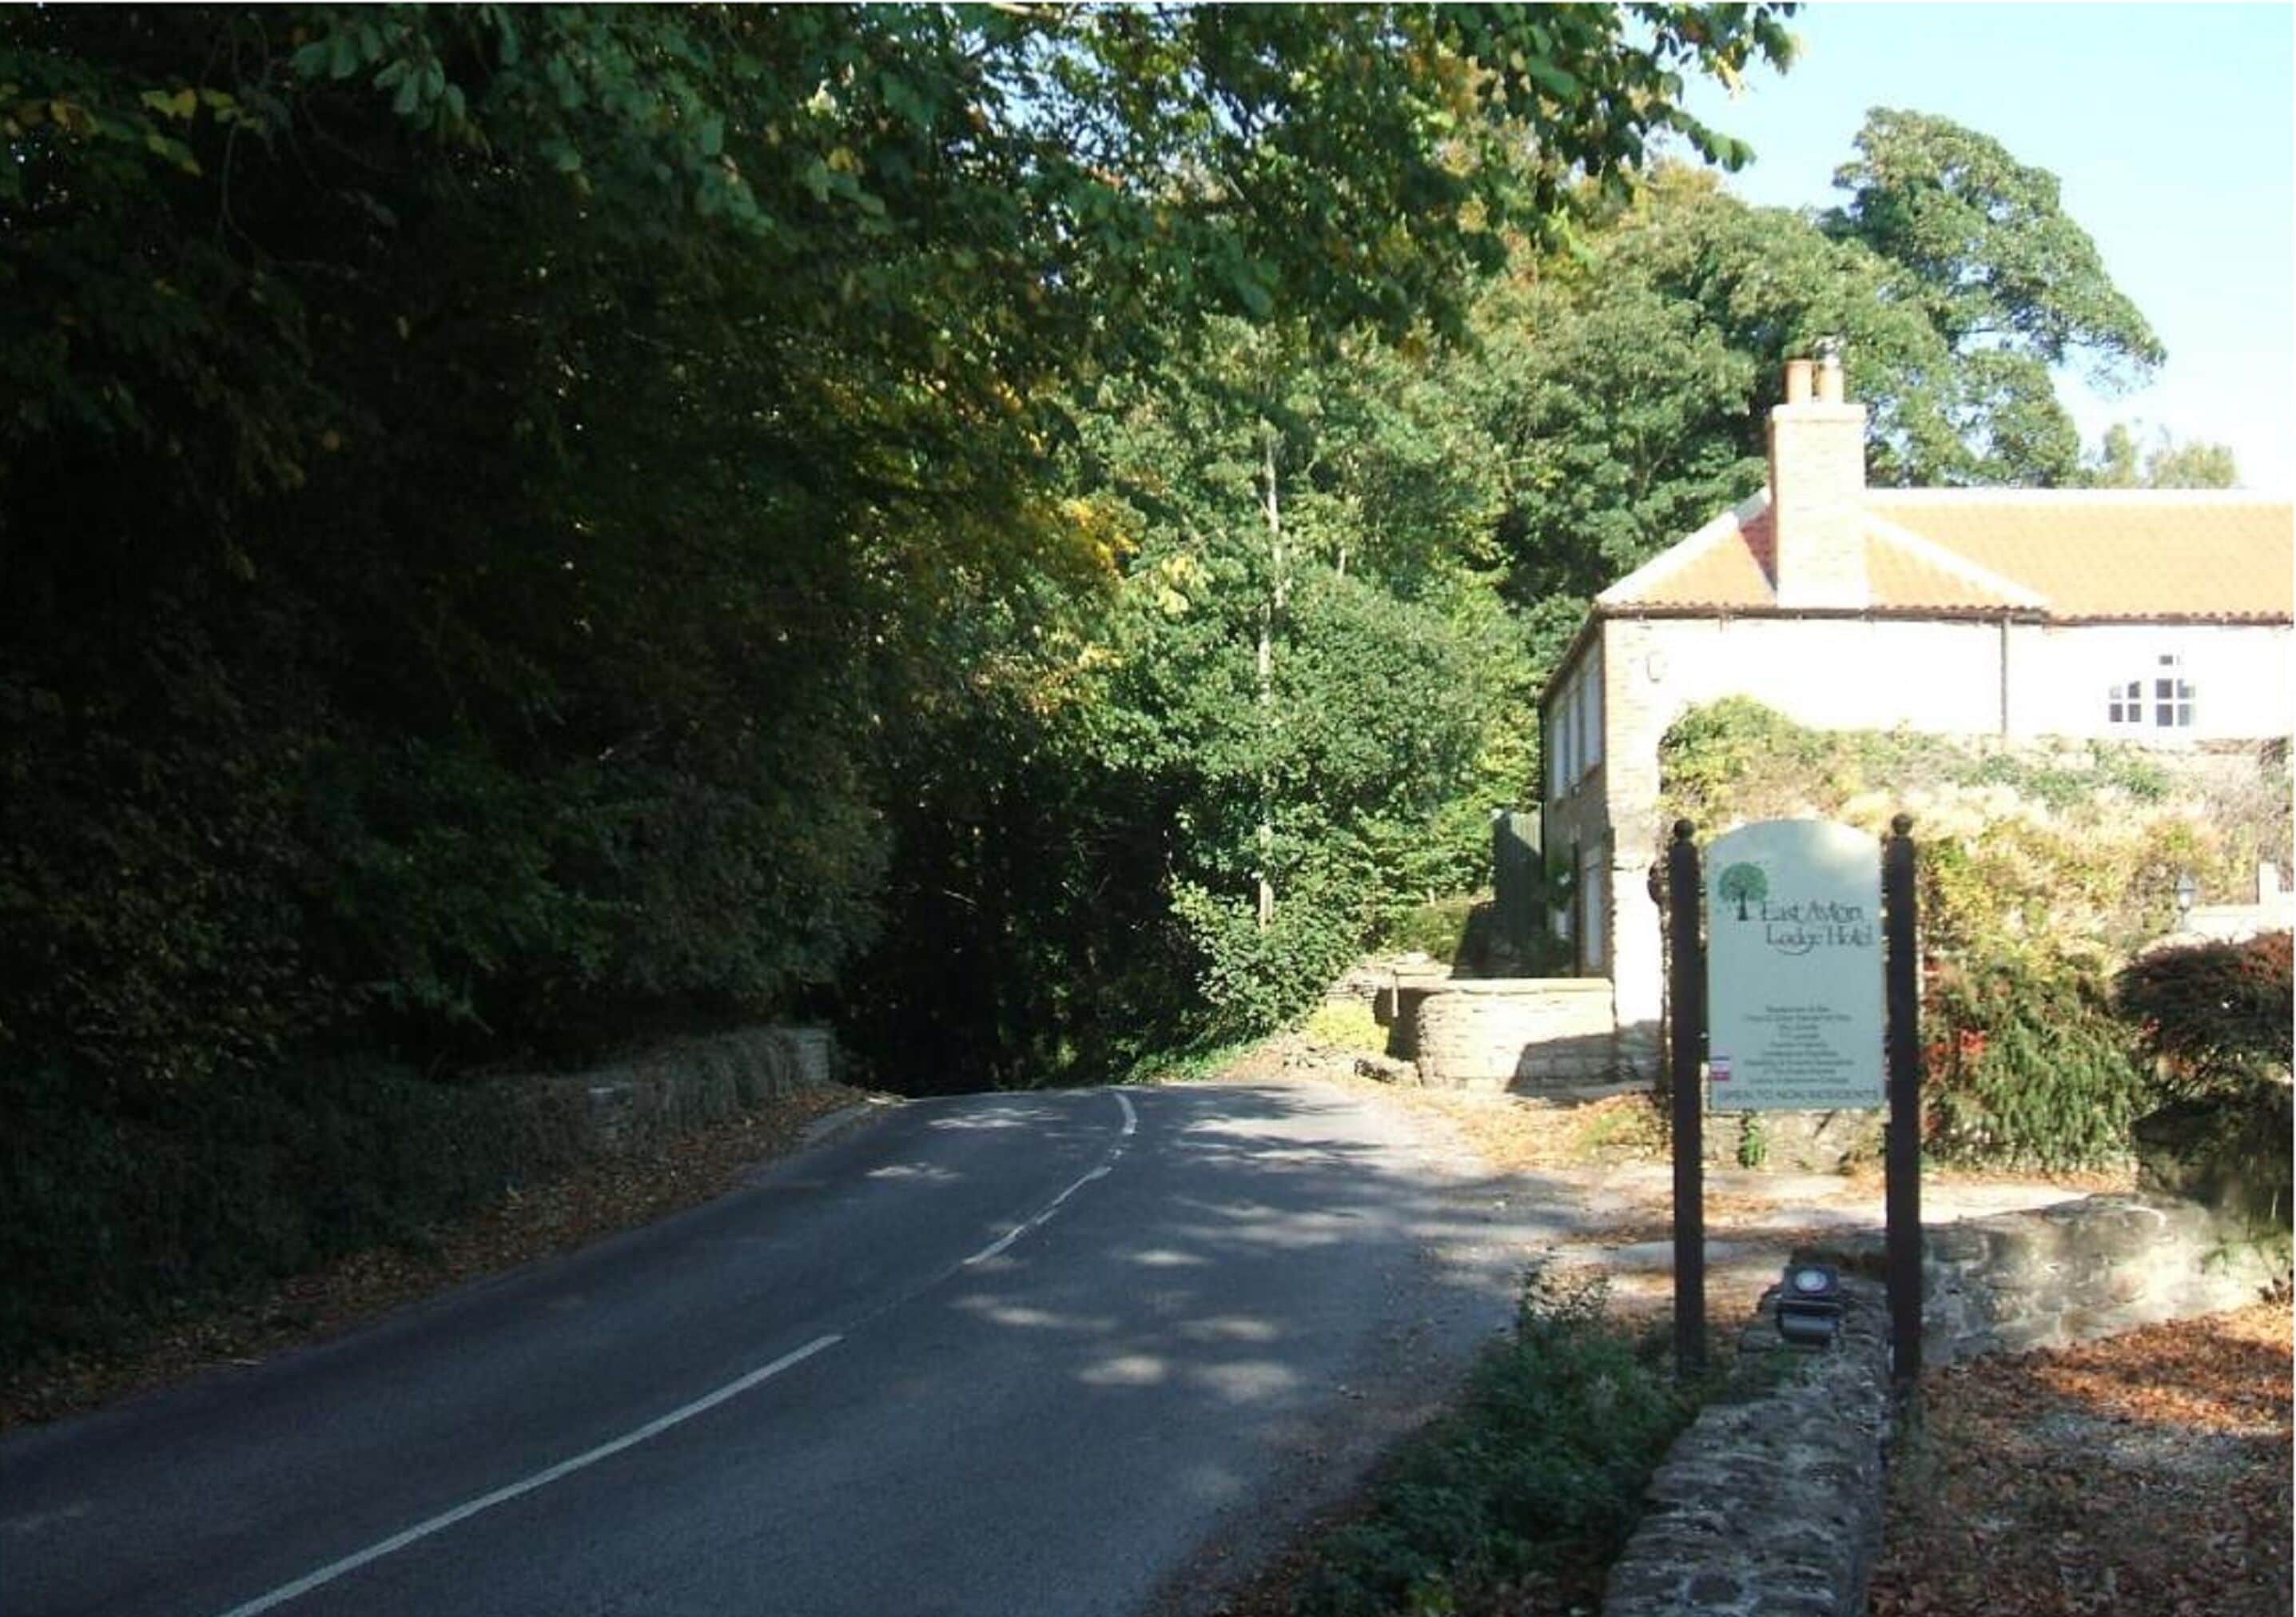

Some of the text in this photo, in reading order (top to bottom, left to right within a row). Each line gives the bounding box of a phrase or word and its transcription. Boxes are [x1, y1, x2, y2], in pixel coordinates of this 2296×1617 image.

[1761, 902, 1801, 922] East
[1766, 923, 1873, 955] Lodge Hotel
[1757, 1089, 1773, 1100] TO
